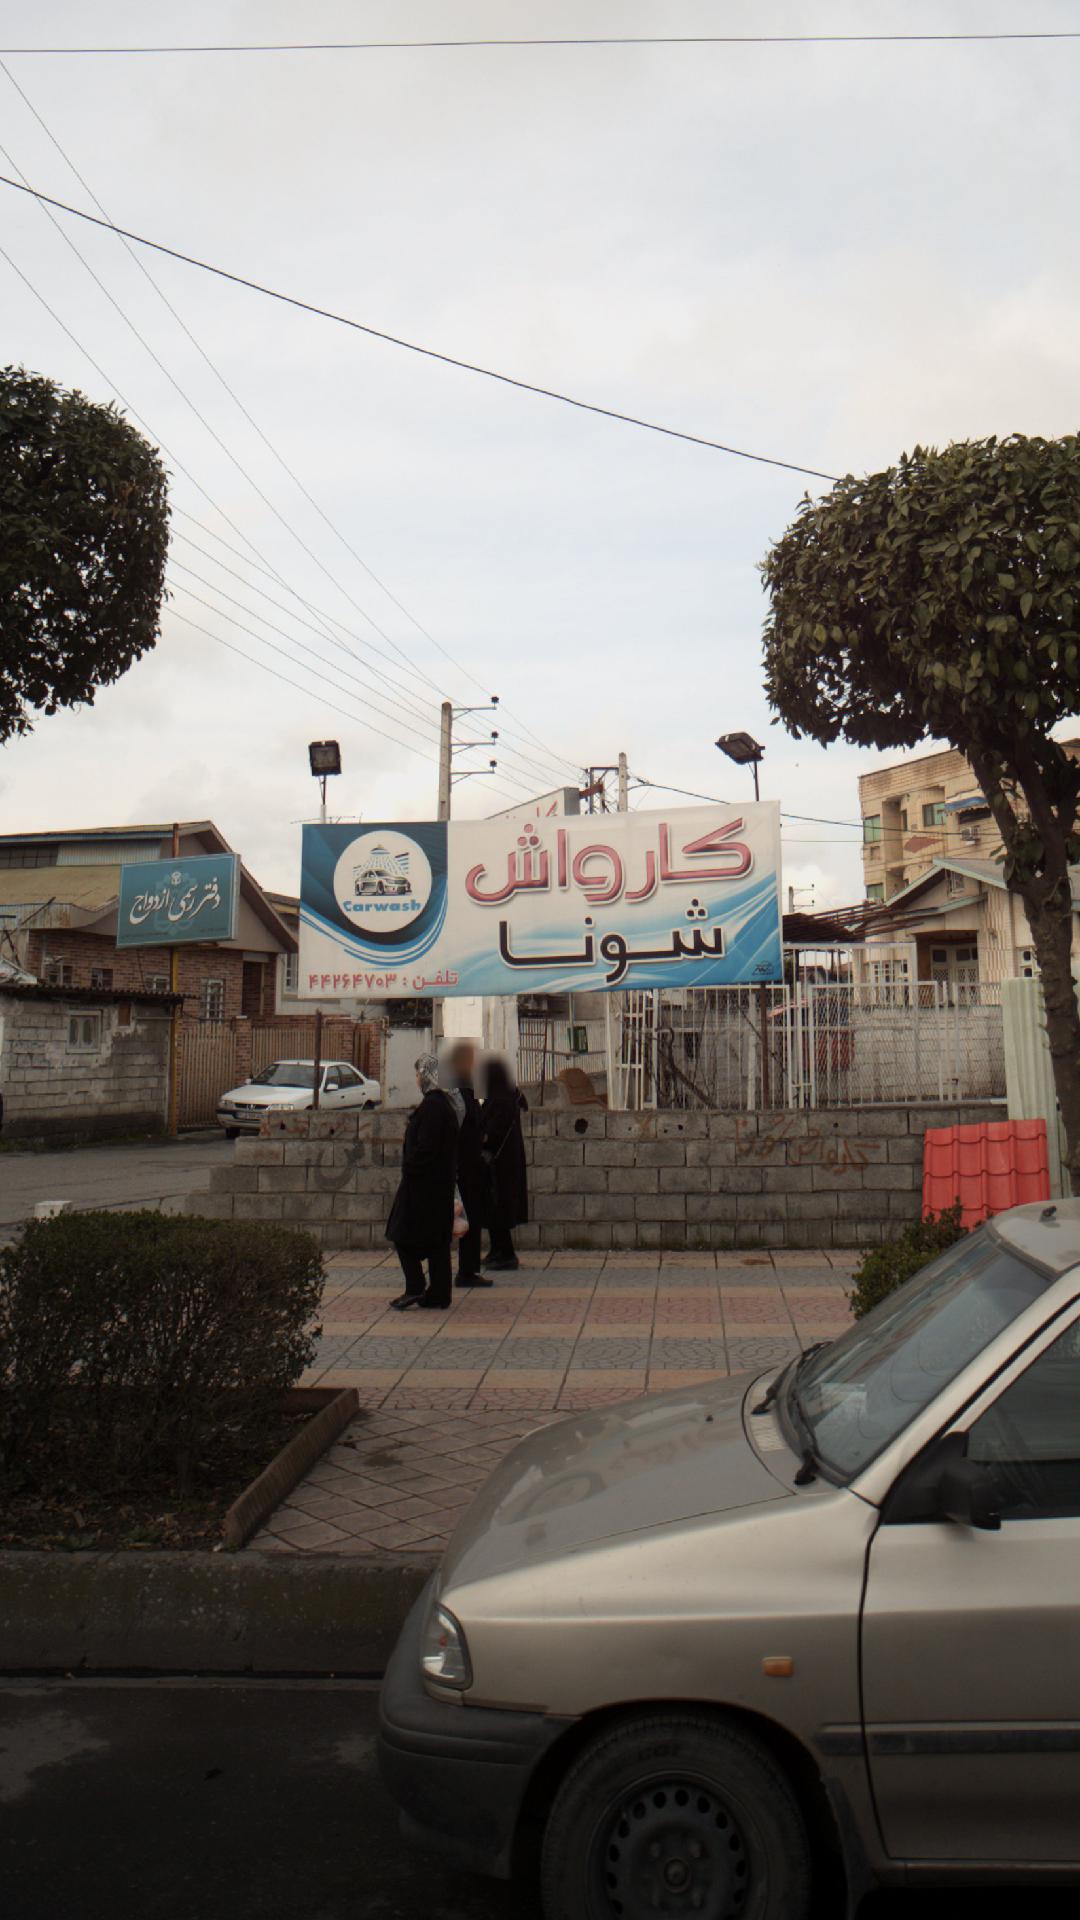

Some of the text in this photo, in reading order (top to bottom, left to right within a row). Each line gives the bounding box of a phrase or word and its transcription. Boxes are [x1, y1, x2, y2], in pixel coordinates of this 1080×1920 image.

[465, 817, 753, 903] کارواش
[129, 877, 221, 925] دفتر رسمی ازدواج
[344, 900, 421, 912] Carwash
[499, 899, 724, 984] شونا
[308, 973, 397, 990] ۴۴۲۶۴۷۰۳
